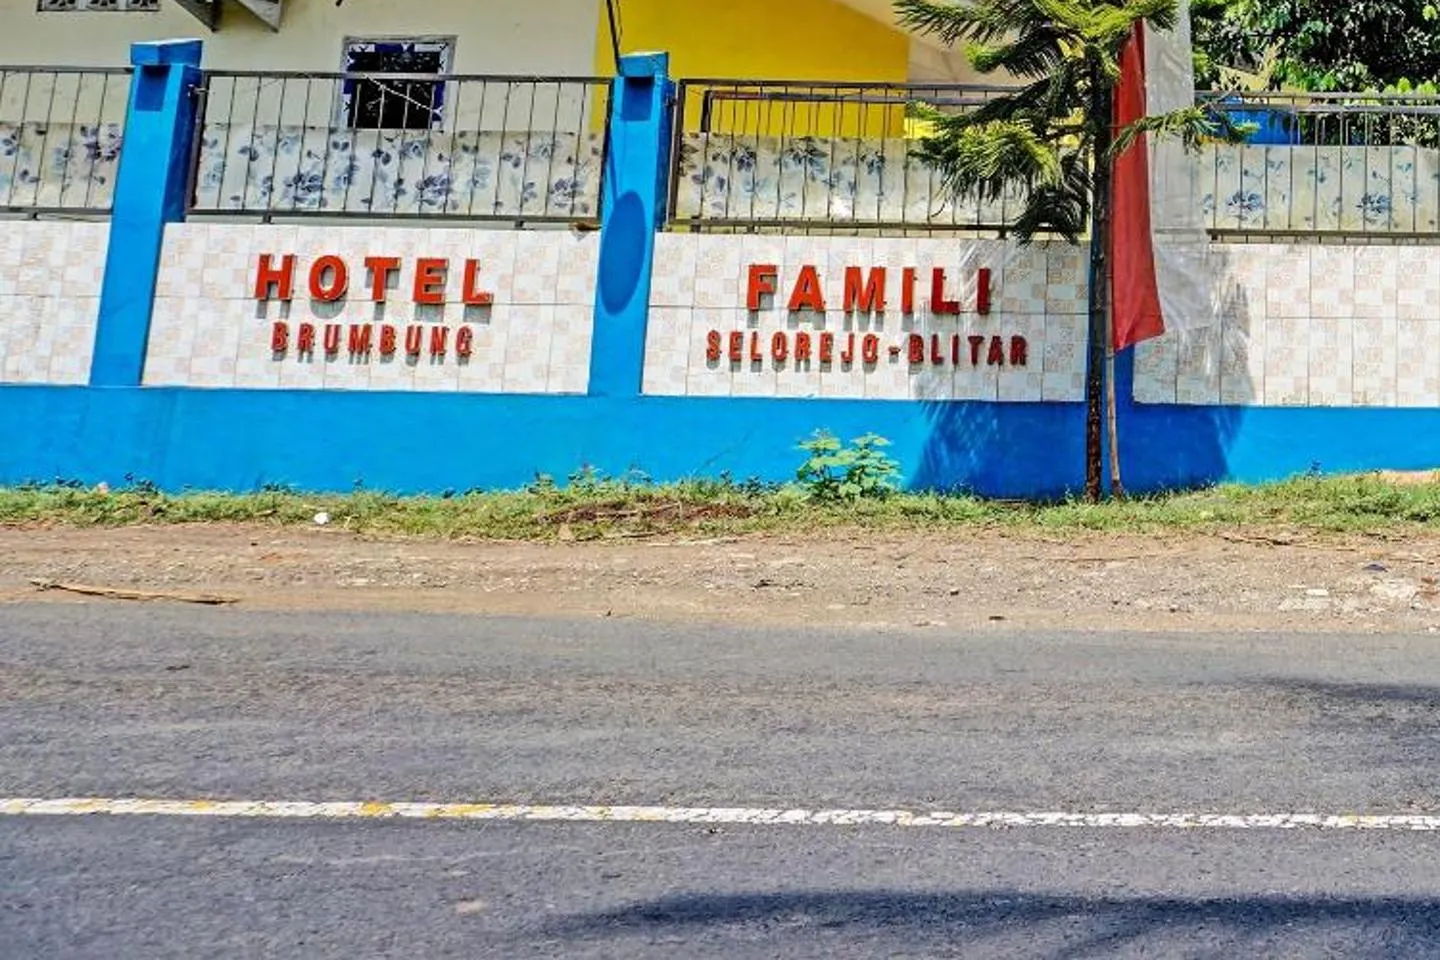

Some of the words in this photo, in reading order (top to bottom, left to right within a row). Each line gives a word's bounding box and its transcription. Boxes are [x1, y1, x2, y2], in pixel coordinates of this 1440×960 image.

[254, 254, 493, 305] HOTEL
[745, 264, 992, 316] FAMILI
[273, 321, 473, 356] BRUMBUNG
